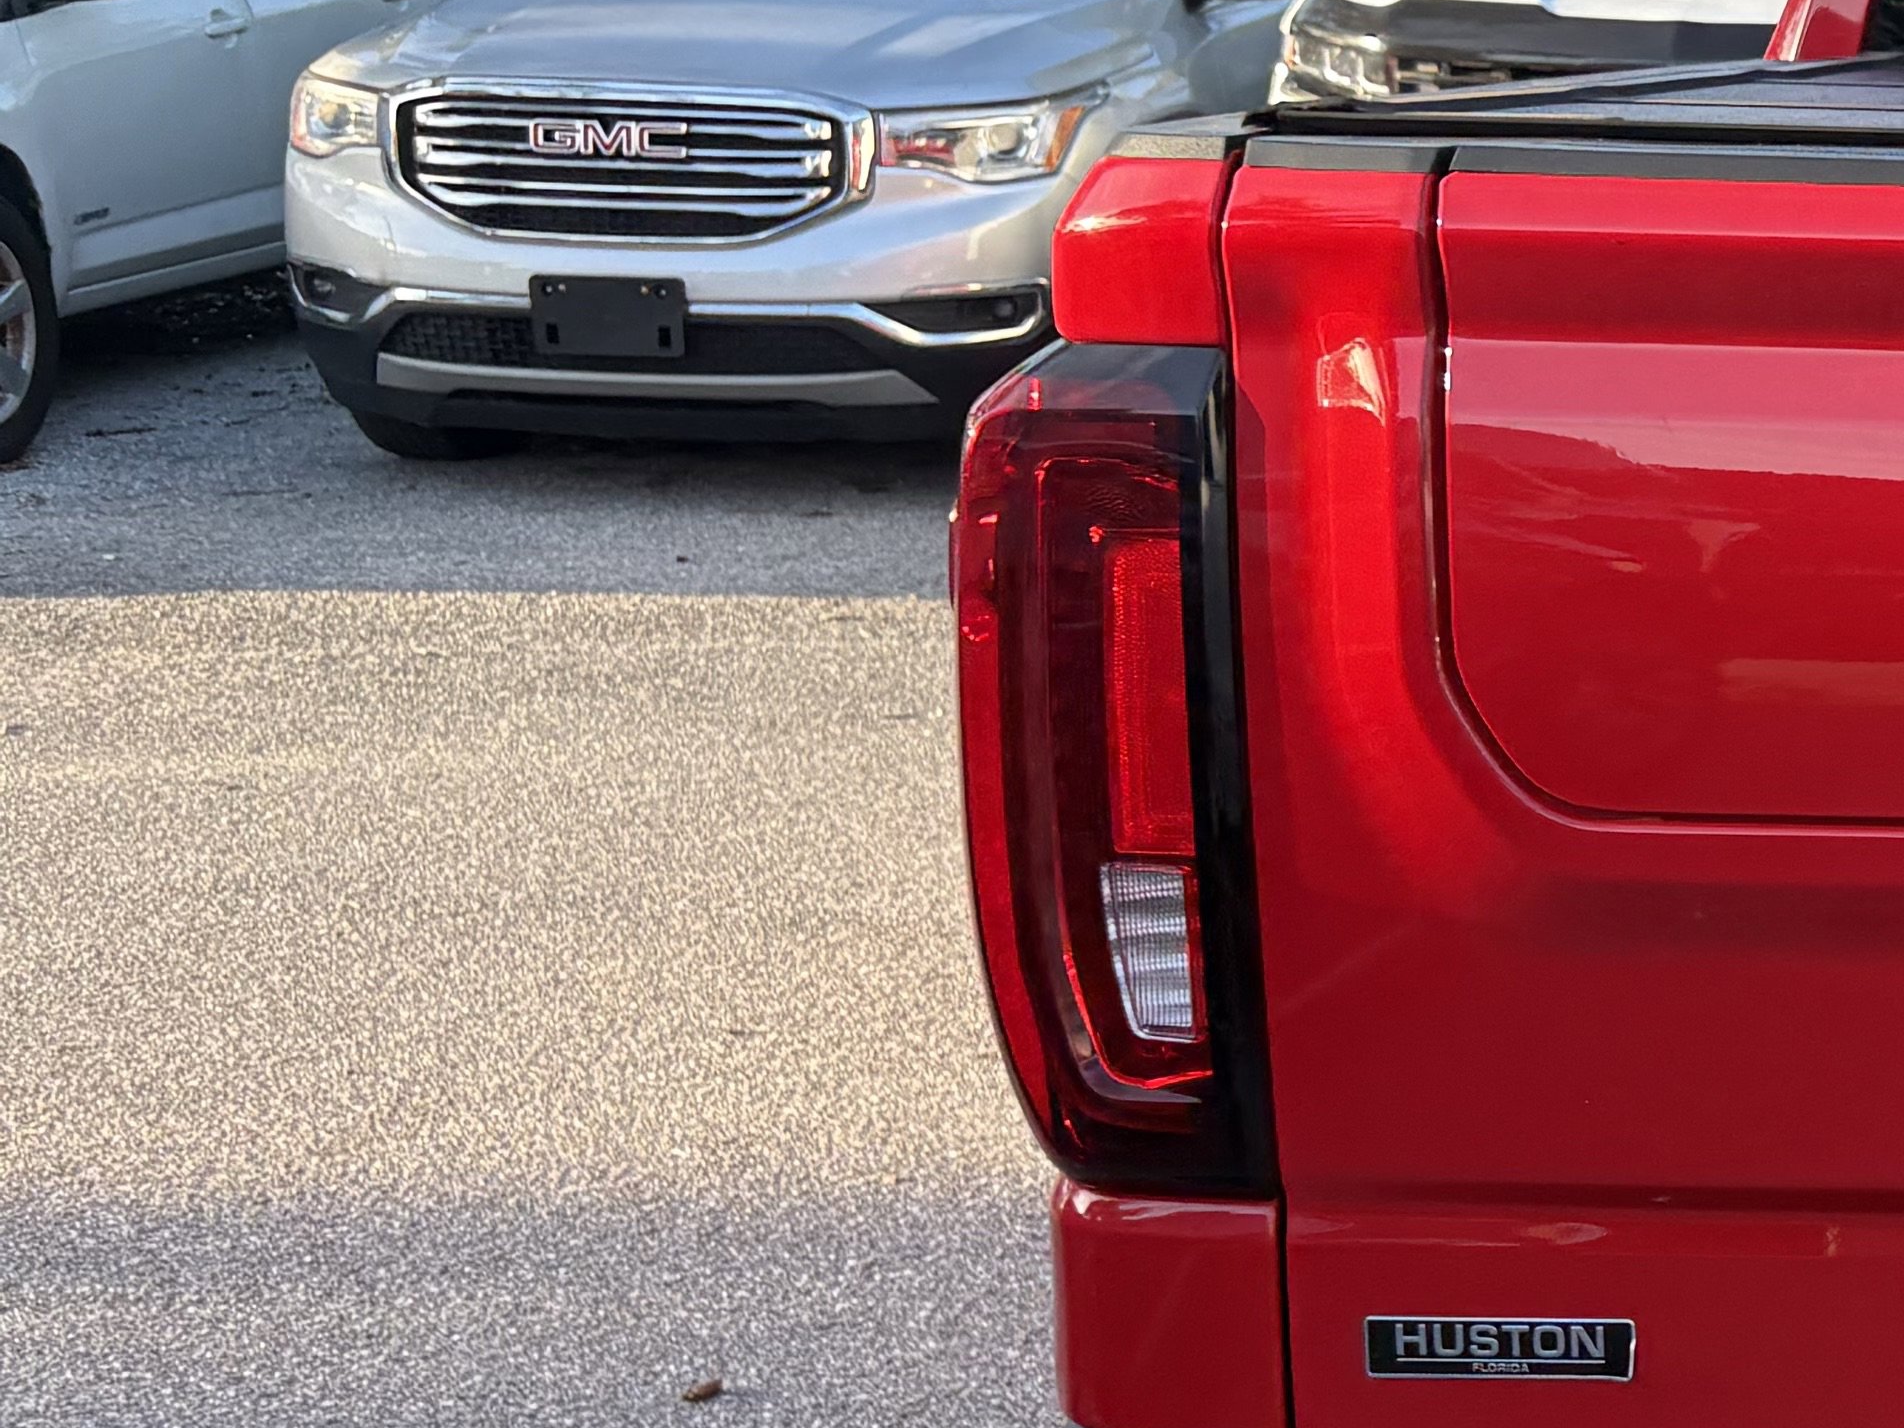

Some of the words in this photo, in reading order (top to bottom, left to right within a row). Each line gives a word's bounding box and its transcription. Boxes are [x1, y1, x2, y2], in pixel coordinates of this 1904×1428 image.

[529, 117, 688, 159] GMC
[1394, 1322, 1606, 1359] HUSTON
[1471, 1361, 1530, 1374] FLORIDA
